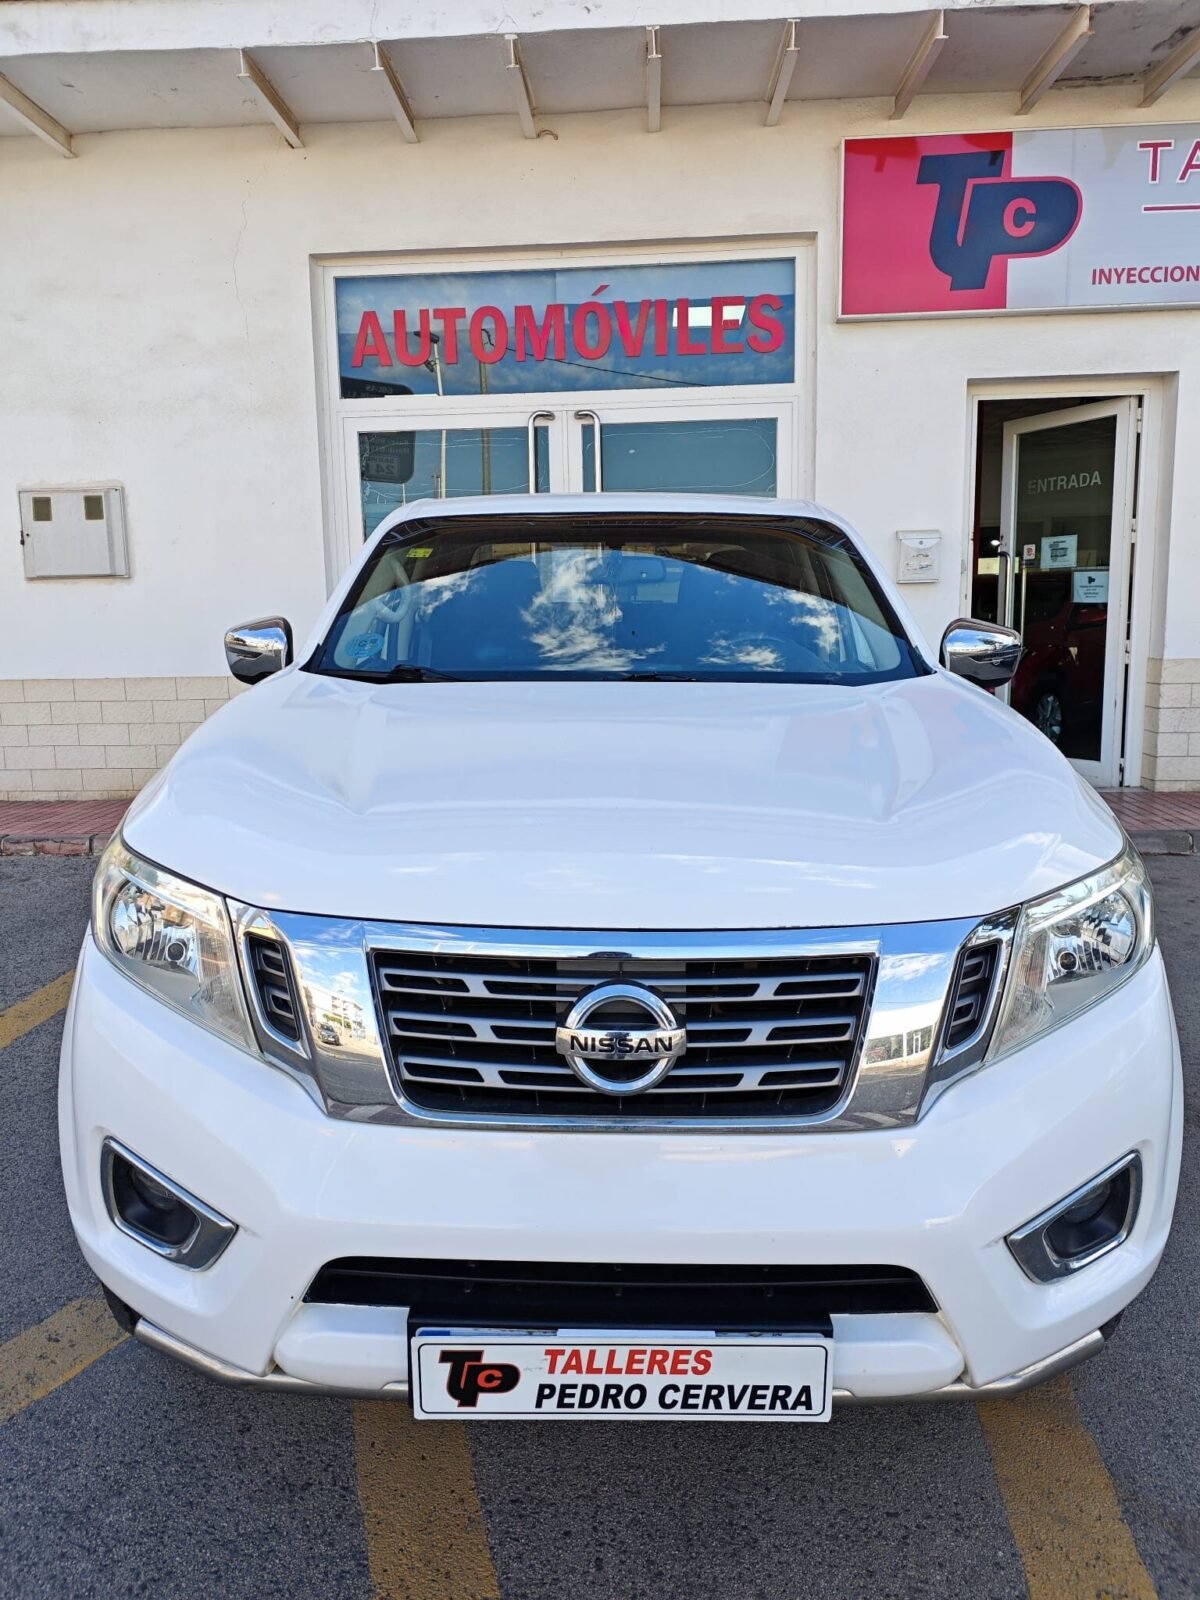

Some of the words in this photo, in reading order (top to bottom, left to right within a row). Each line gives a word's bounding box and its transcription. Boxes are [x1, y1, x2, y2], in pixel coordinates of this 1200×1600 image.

[1091, 265, 1200, 285] INYECCION
[351, 284, 786, 368] AUTOMÓVILES
[1028, 471, 1101, 494] ENTRADA
[570, 1035, 673, 1054] NISSAN
[543, 1349, 713, 1375] TALLERES
[534, 1383, 648, 1410] PEDRO
[658, 1384, 813, 1411] CERVERA
